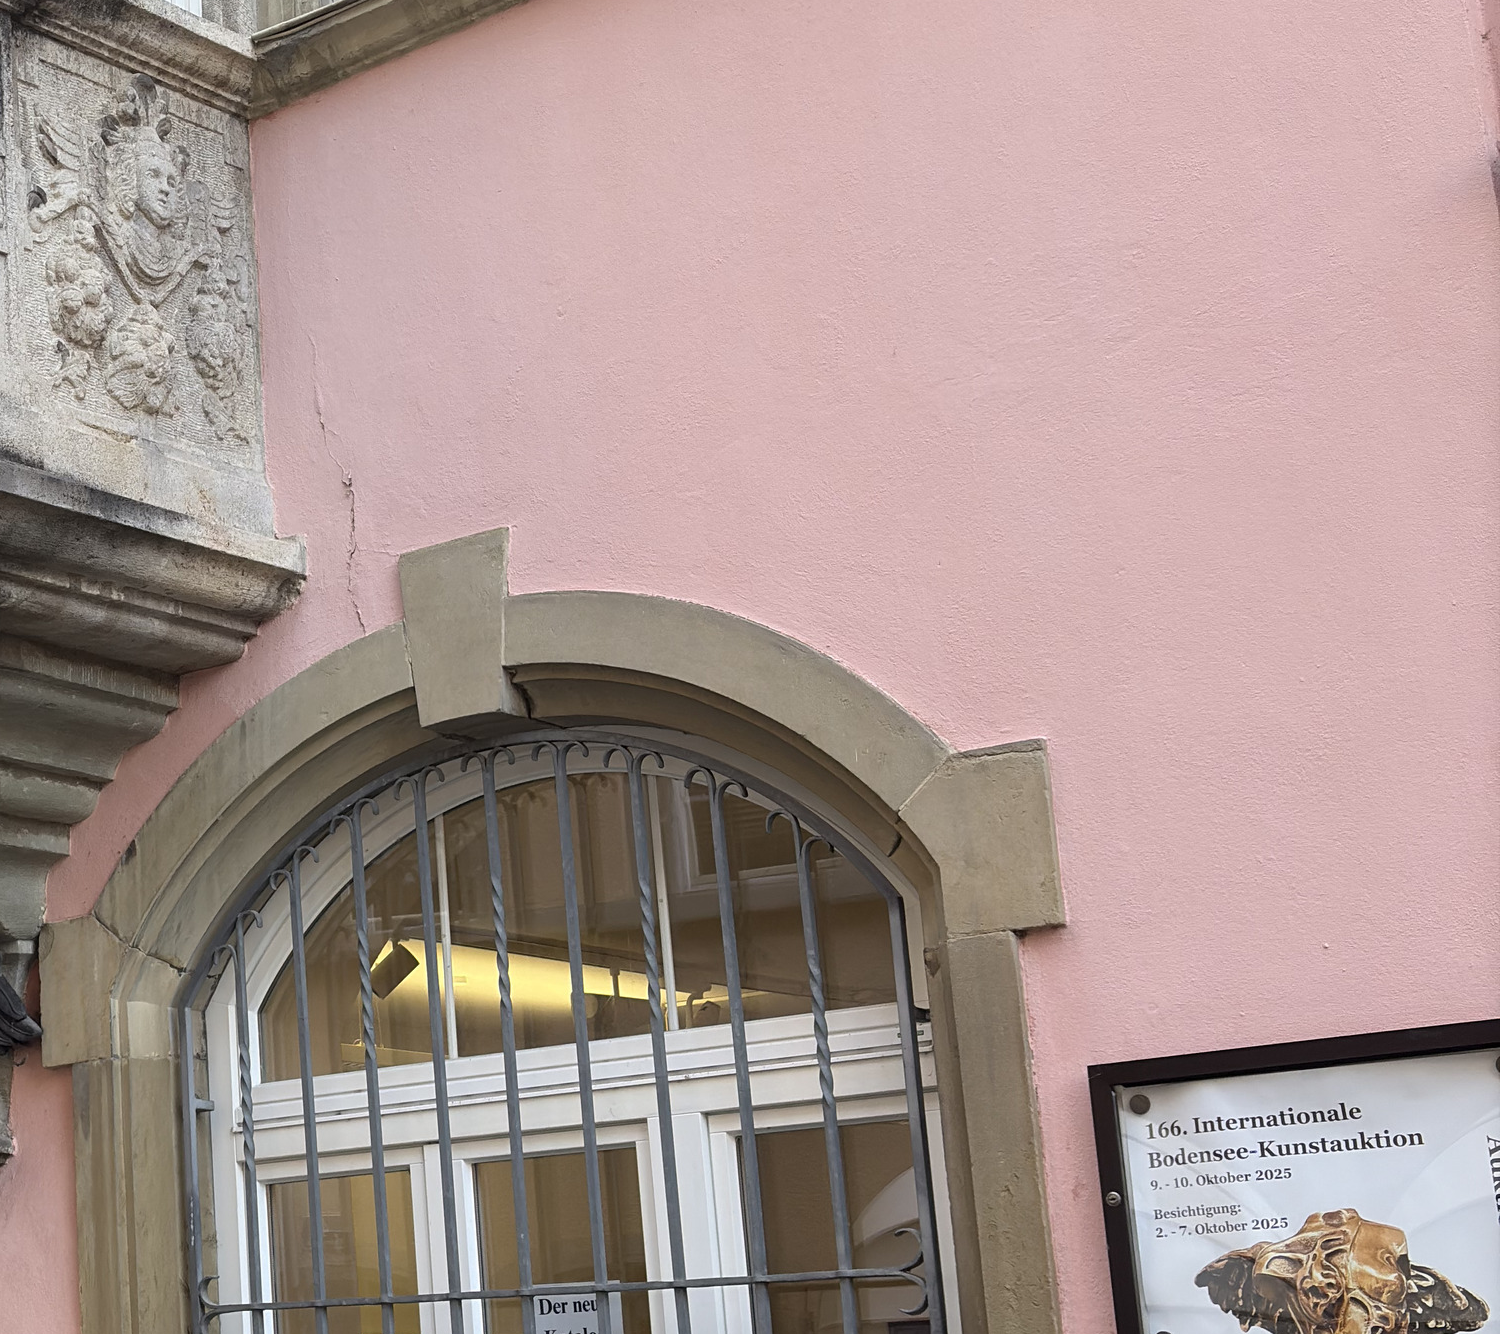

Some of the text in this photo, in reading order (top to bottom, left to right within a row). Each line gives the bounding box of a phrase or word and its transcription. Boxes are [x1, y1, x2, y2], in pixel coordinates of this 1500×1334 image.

[1145, 1102, 1363, 1140] 166. Internationale
[1147, 1129, 1425, 1169] Bodensee-Kunstauktion
[1150, 1179, 1163, 1191] 9.
[1173, 1176, 1193, 1189] 10.
[1195, 1171, 1252, 1187] Oktober
[1254, 1167, 1293, 1182] 2025
[1153, 1203, 1242, 1221] Besichtigung:
[1155, 1227, 1168, 1238] 2.
[1179, 1225, 1192, 1237] 7.
[1194, 1219, 1248, 1236] Oktober
[1251, 1216, 1290, 1231] 2025
[538, 1298, 598, 1316] Der neu
